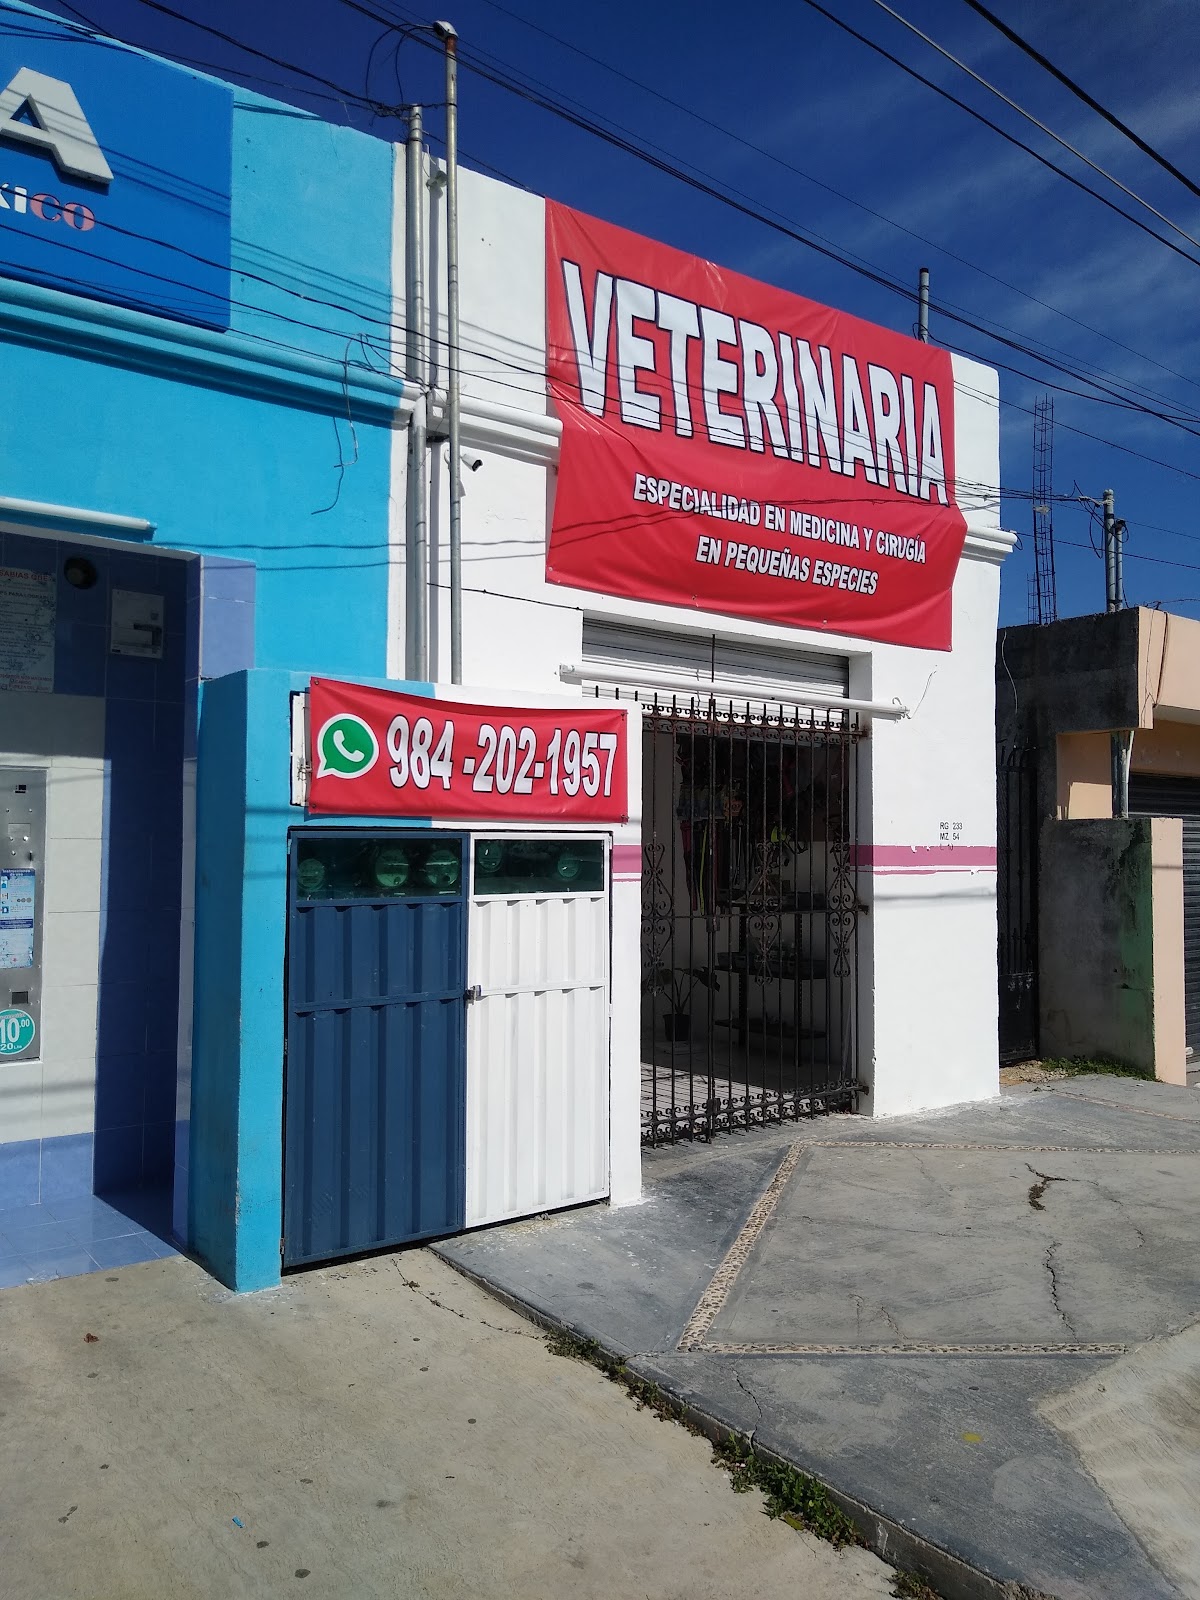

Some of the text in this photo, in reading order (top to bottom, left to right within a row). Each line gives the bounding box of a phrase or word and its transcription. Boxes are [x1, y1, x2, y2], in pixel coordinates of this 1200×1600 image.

[561, 257, 950, 507] VETERINARIA
[633, 472, 926, 564] ESPECIALIDAD EN MEDICINA Y CIRUGÍA
[695, 535, 879, 595] EN PEQUEÑAS ESPECIES
[940, 822, 963, 830] RG 233
[940, 832, 960, 841] MZ 54
